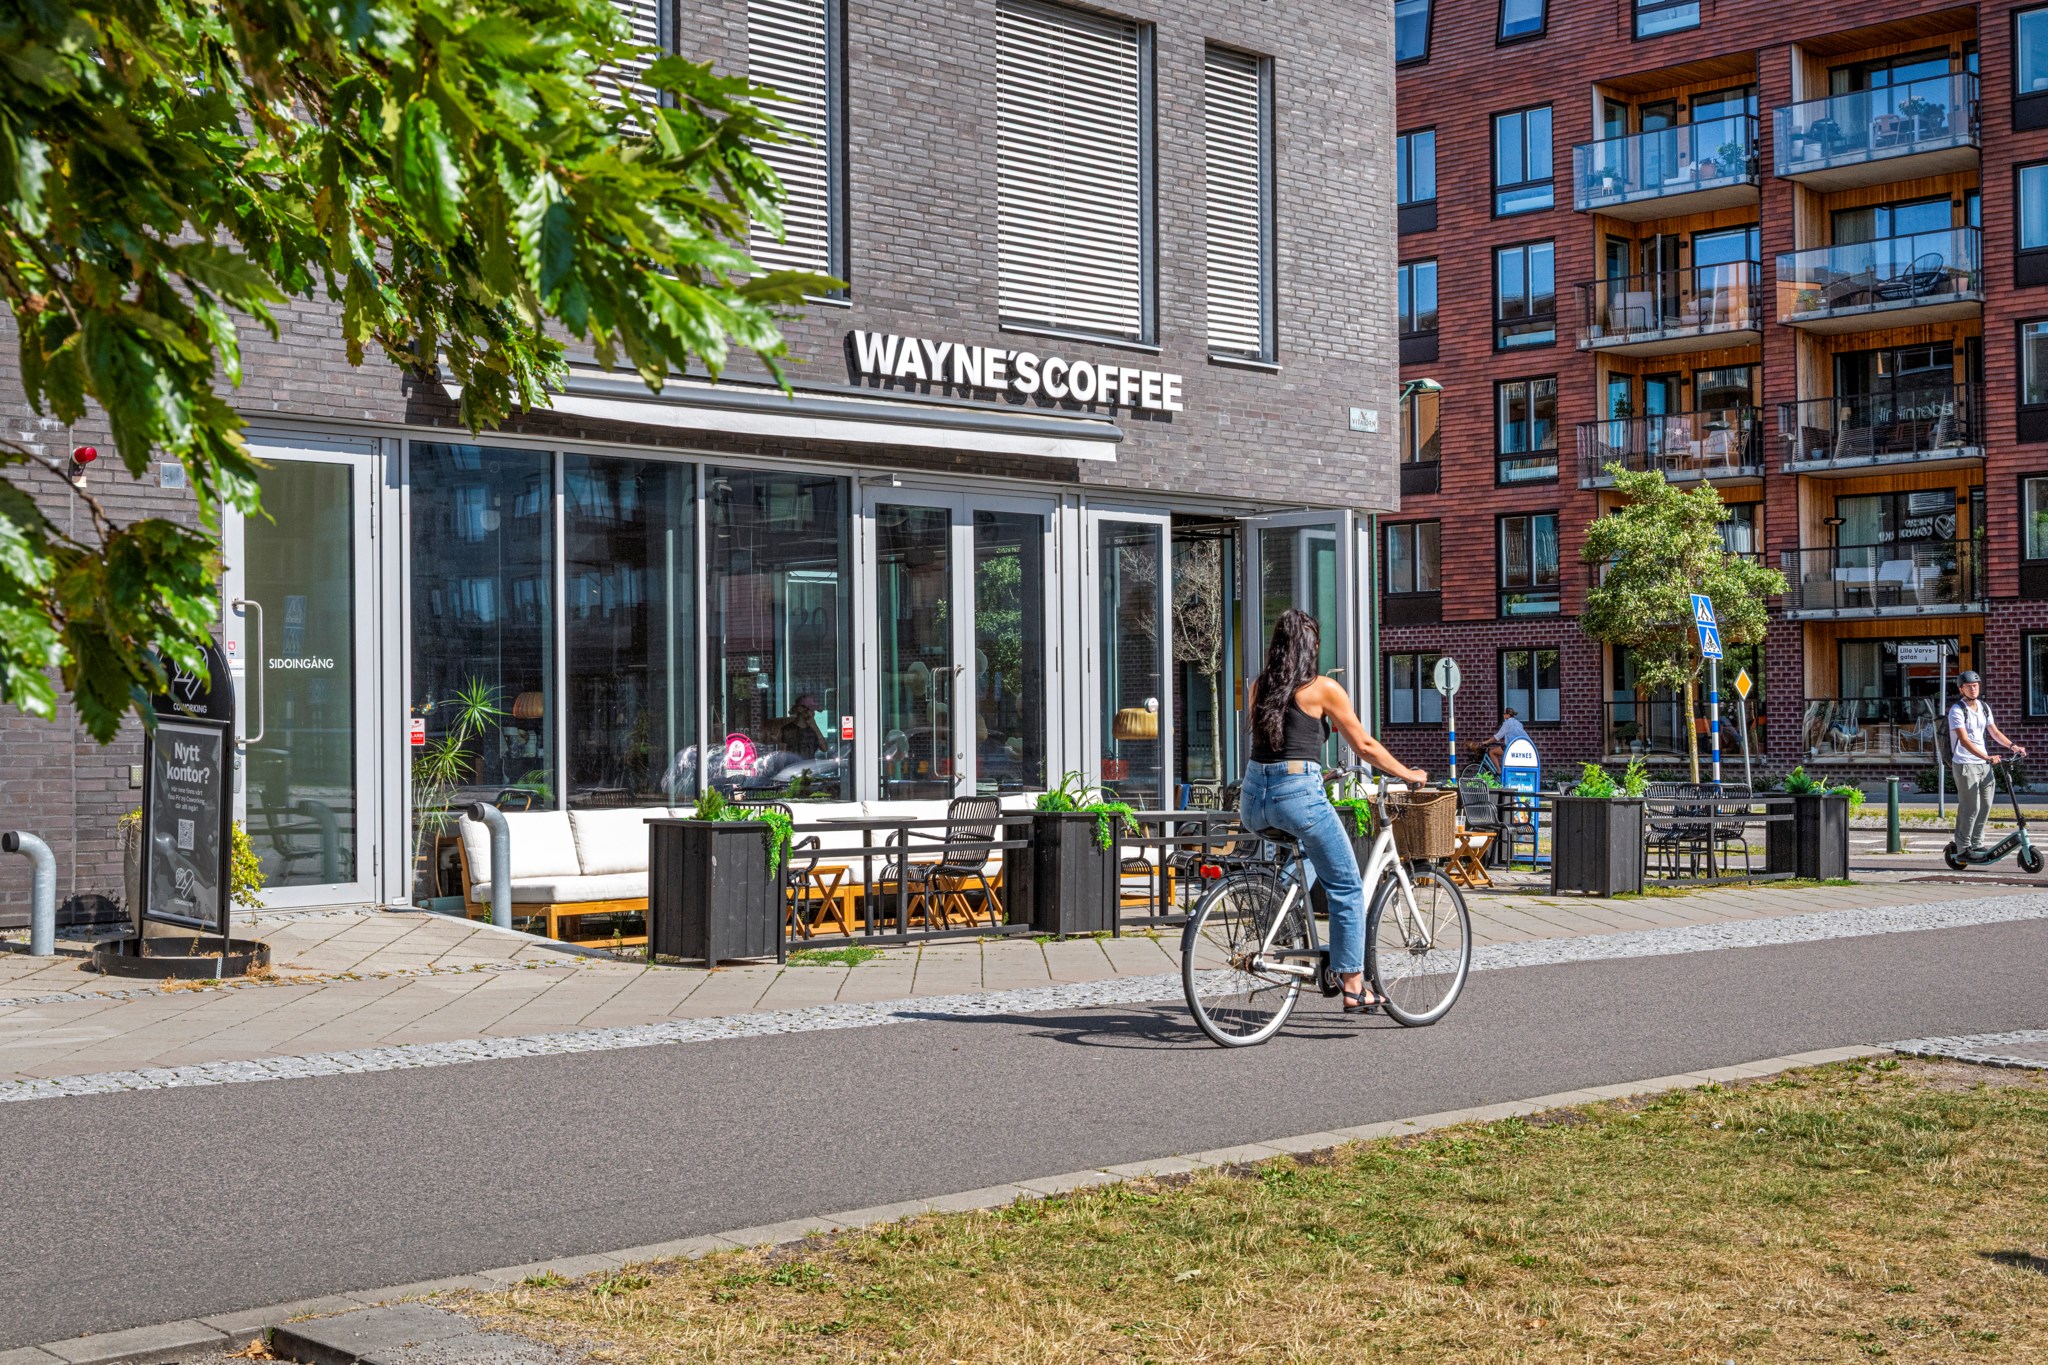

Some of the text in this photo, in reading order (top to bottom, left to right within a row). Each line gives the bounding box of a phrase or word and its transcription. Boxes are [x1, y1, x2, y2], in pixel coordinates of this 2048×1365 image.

[854, 329, 1184, 412] WAYNE'S COFFEE
[269, 656, 334, 669] SIDOINGÅNG
[174, 742, 200, 765] Nytt
[166, 760, 210, 784] kontor?
[1993, 841, 2012, 856] PURE
